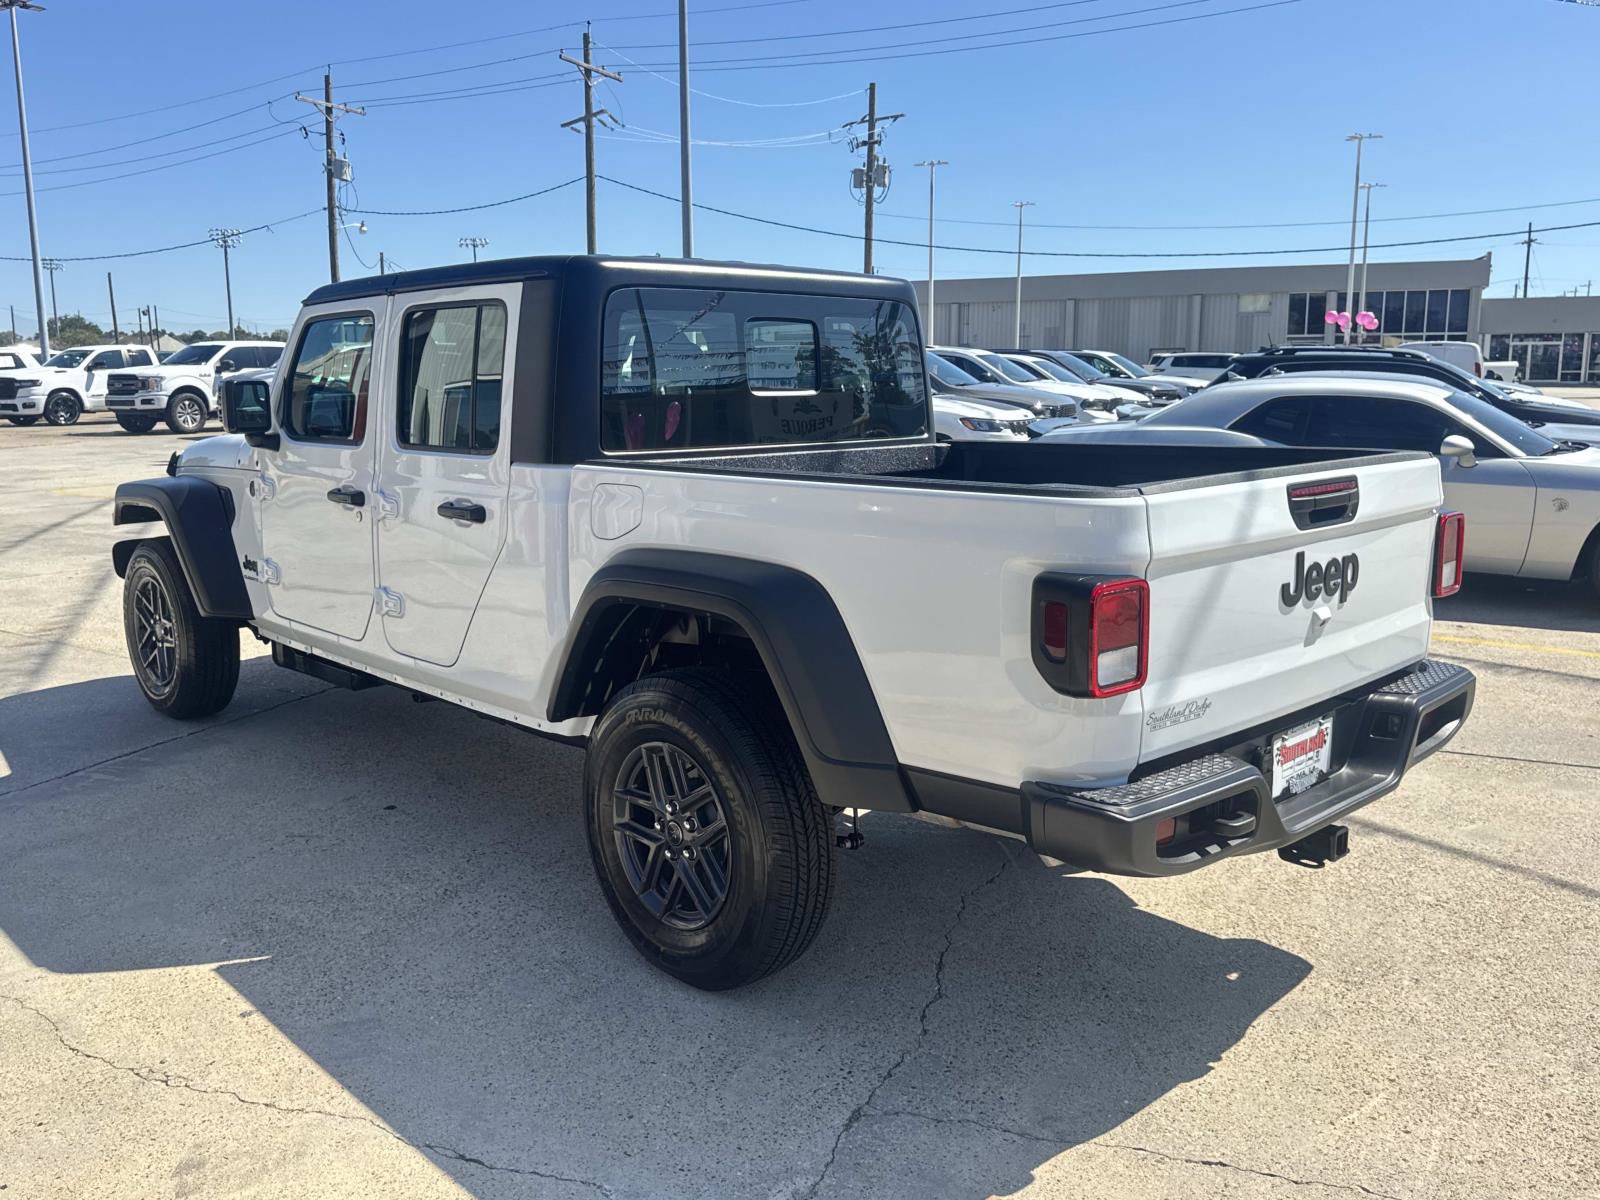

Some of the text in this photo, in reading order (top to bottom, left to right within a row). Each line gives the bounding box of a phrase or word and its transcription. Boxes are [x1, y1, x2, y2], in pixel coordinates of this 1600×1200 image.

[243, 554, 259, 576] Jeep
[1282, 551, 1359, 607] Jeep
[1146, 706, 1189, 726] Southland
[1188, 697, 1212, 716] Dodge
[1280, 728, 1325, 766] SOUTHLAND
